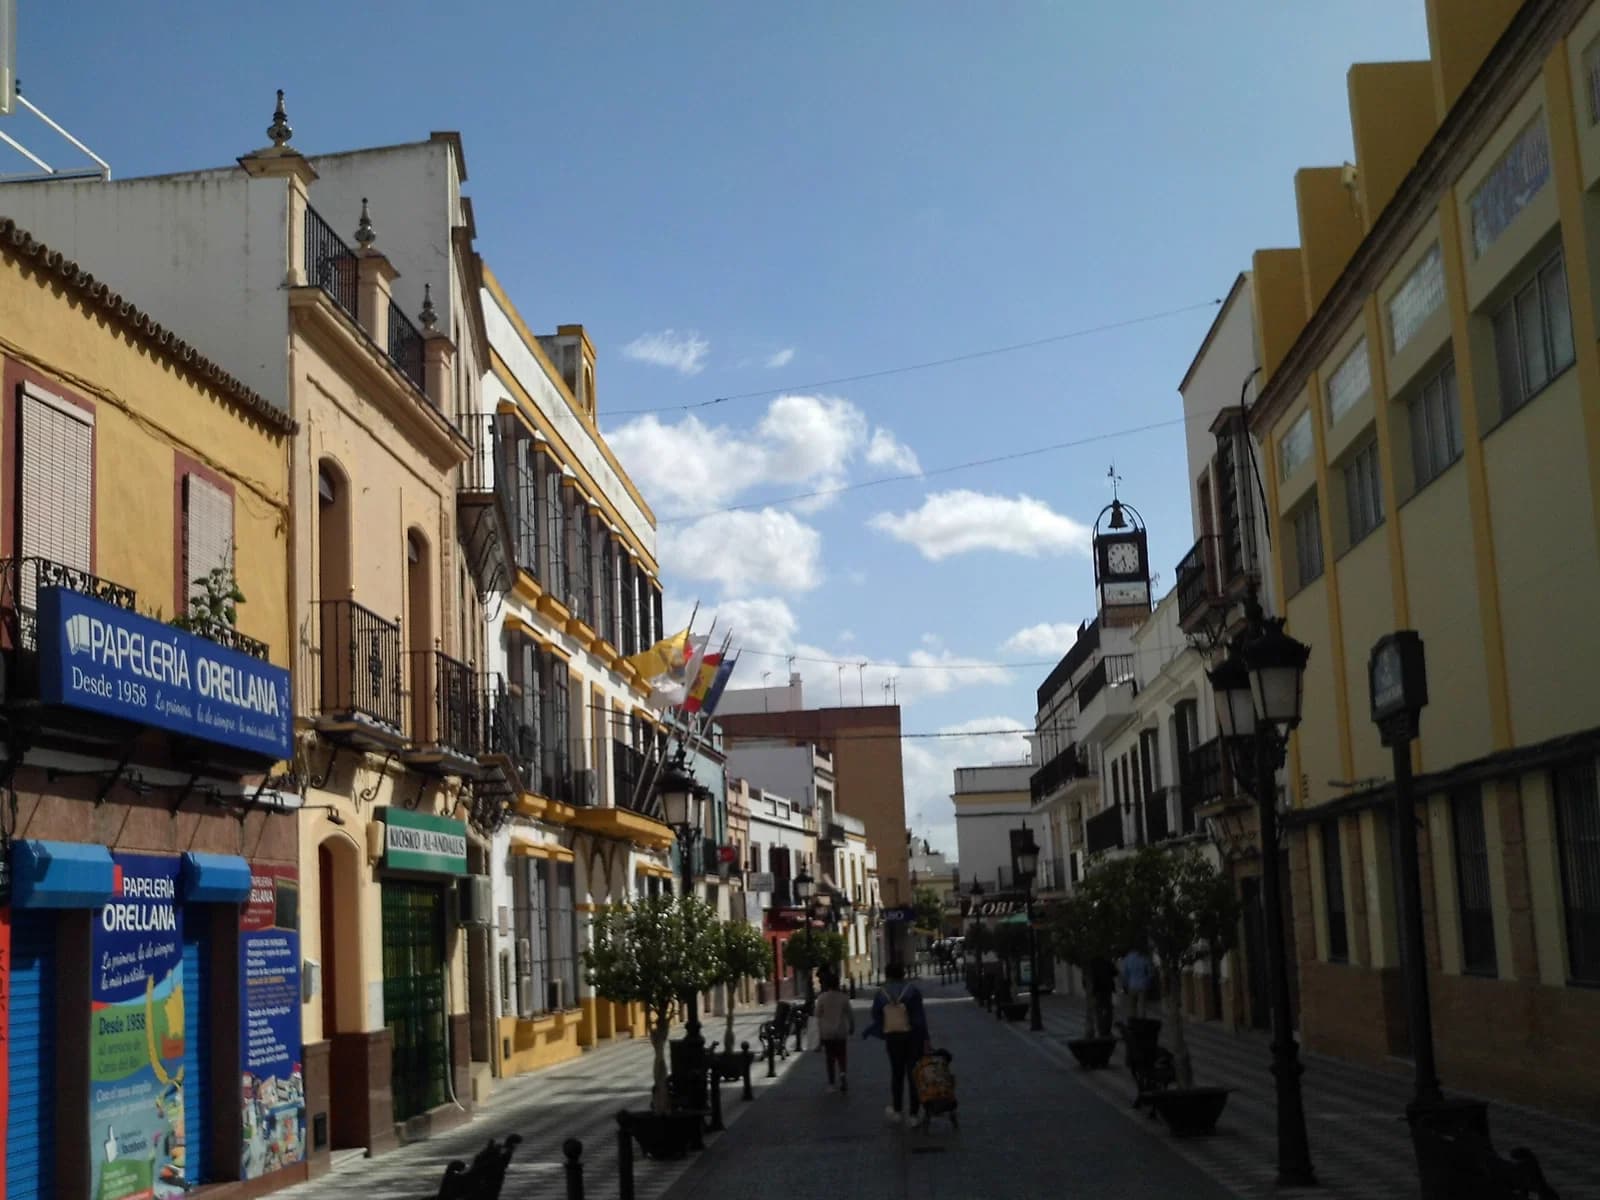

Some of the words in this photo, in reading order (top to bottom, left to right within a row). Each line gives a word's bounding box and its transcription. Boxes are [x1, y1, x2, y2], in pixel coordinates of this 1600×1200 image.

[90, 618, 191, 690] PAPELERÍA
[197, 656, 279, 717] ORELLANA
[72, 665, 112, 698] Desde
[117, 679, 148, 707] 1958
[390, 827, 420, 850] KIOSKO
[423, 833, 465, 855] AL-ANDALUS
[123, 874, 175, 899] PAPELERÍA
[103, 903, 176, 932] ORELLANA
[99, 1017, 123, 1036] Desde
[126, 1013, 146, 1032] 1958
